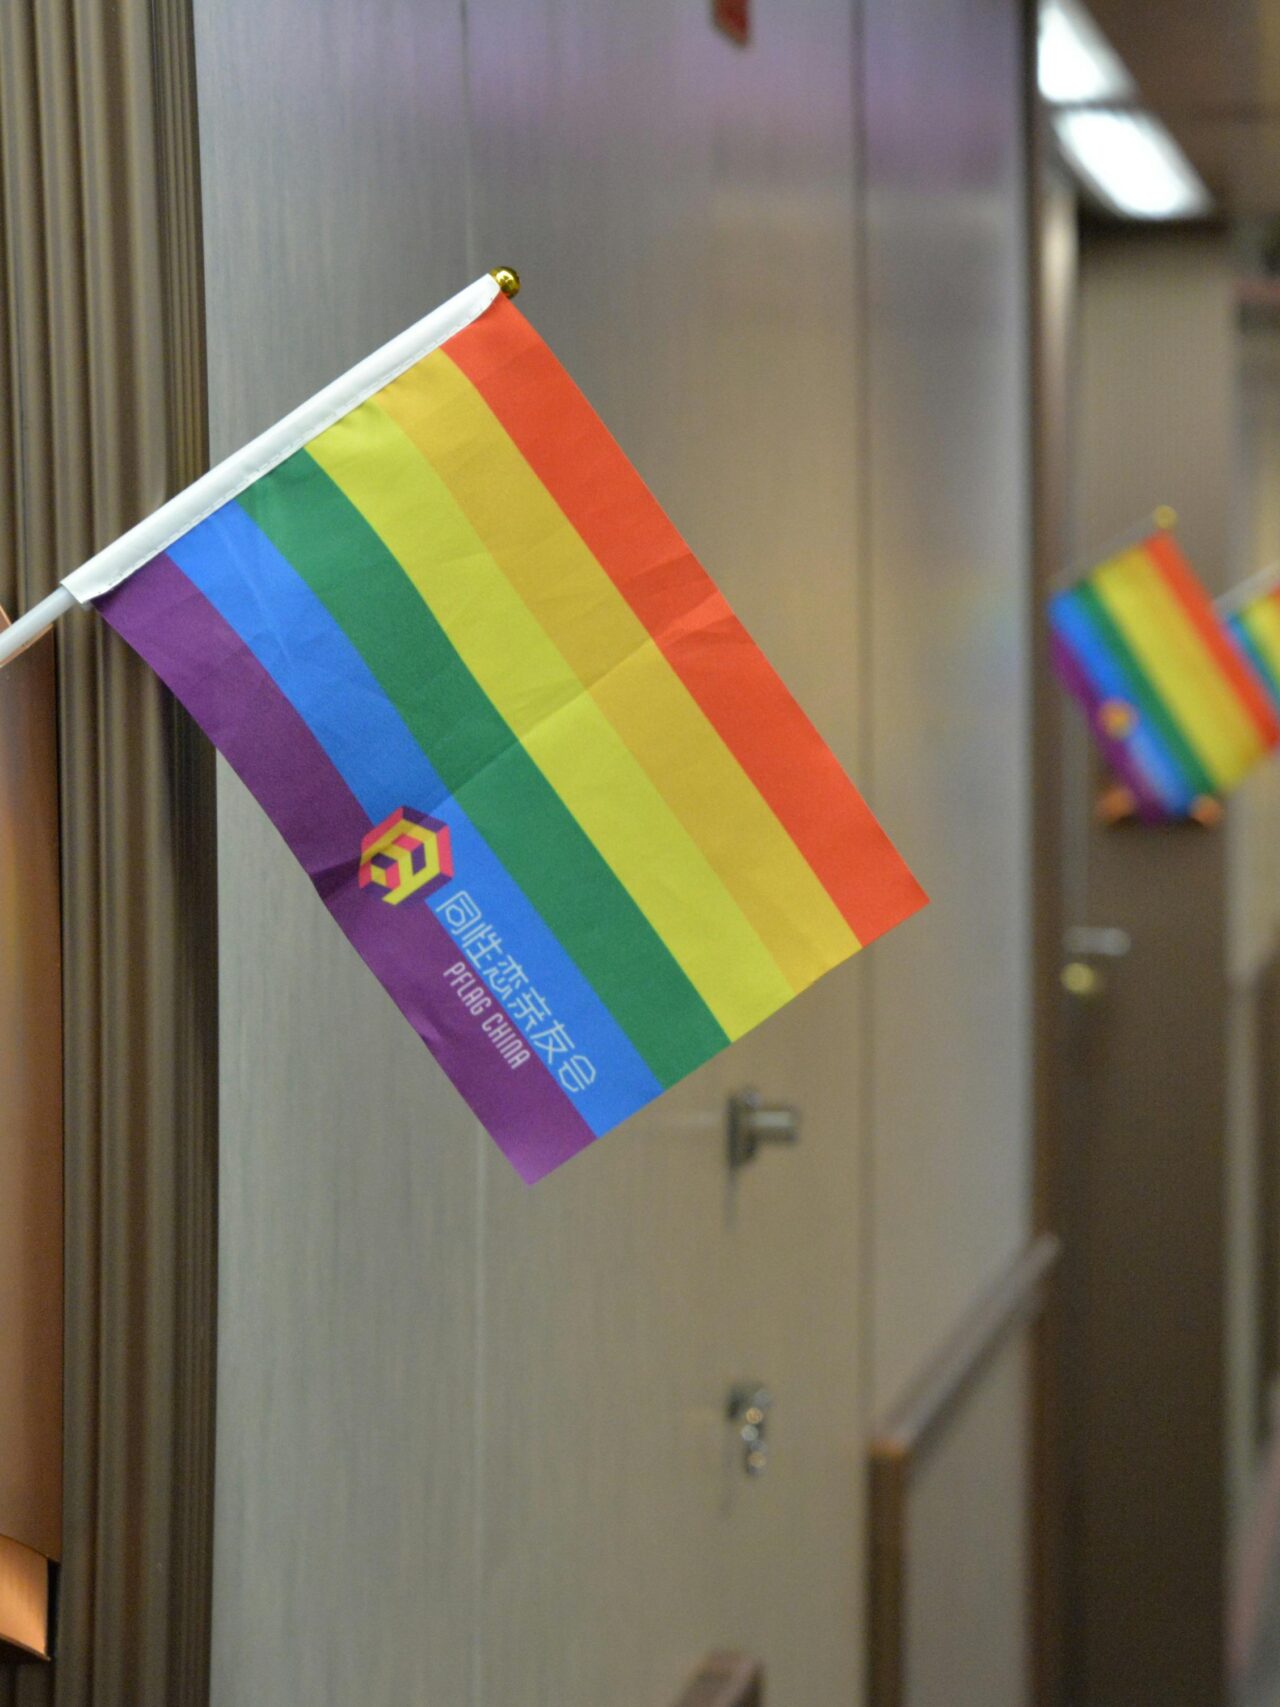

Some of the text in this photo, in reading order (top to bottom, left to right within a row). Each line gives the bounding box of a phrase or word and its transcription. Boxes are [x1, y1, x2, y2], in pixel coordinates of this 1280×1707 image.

[436, 891, 597, 1092] 同性恋亲友会
[443, 961, 531, 1069] PFLAG CHINA
